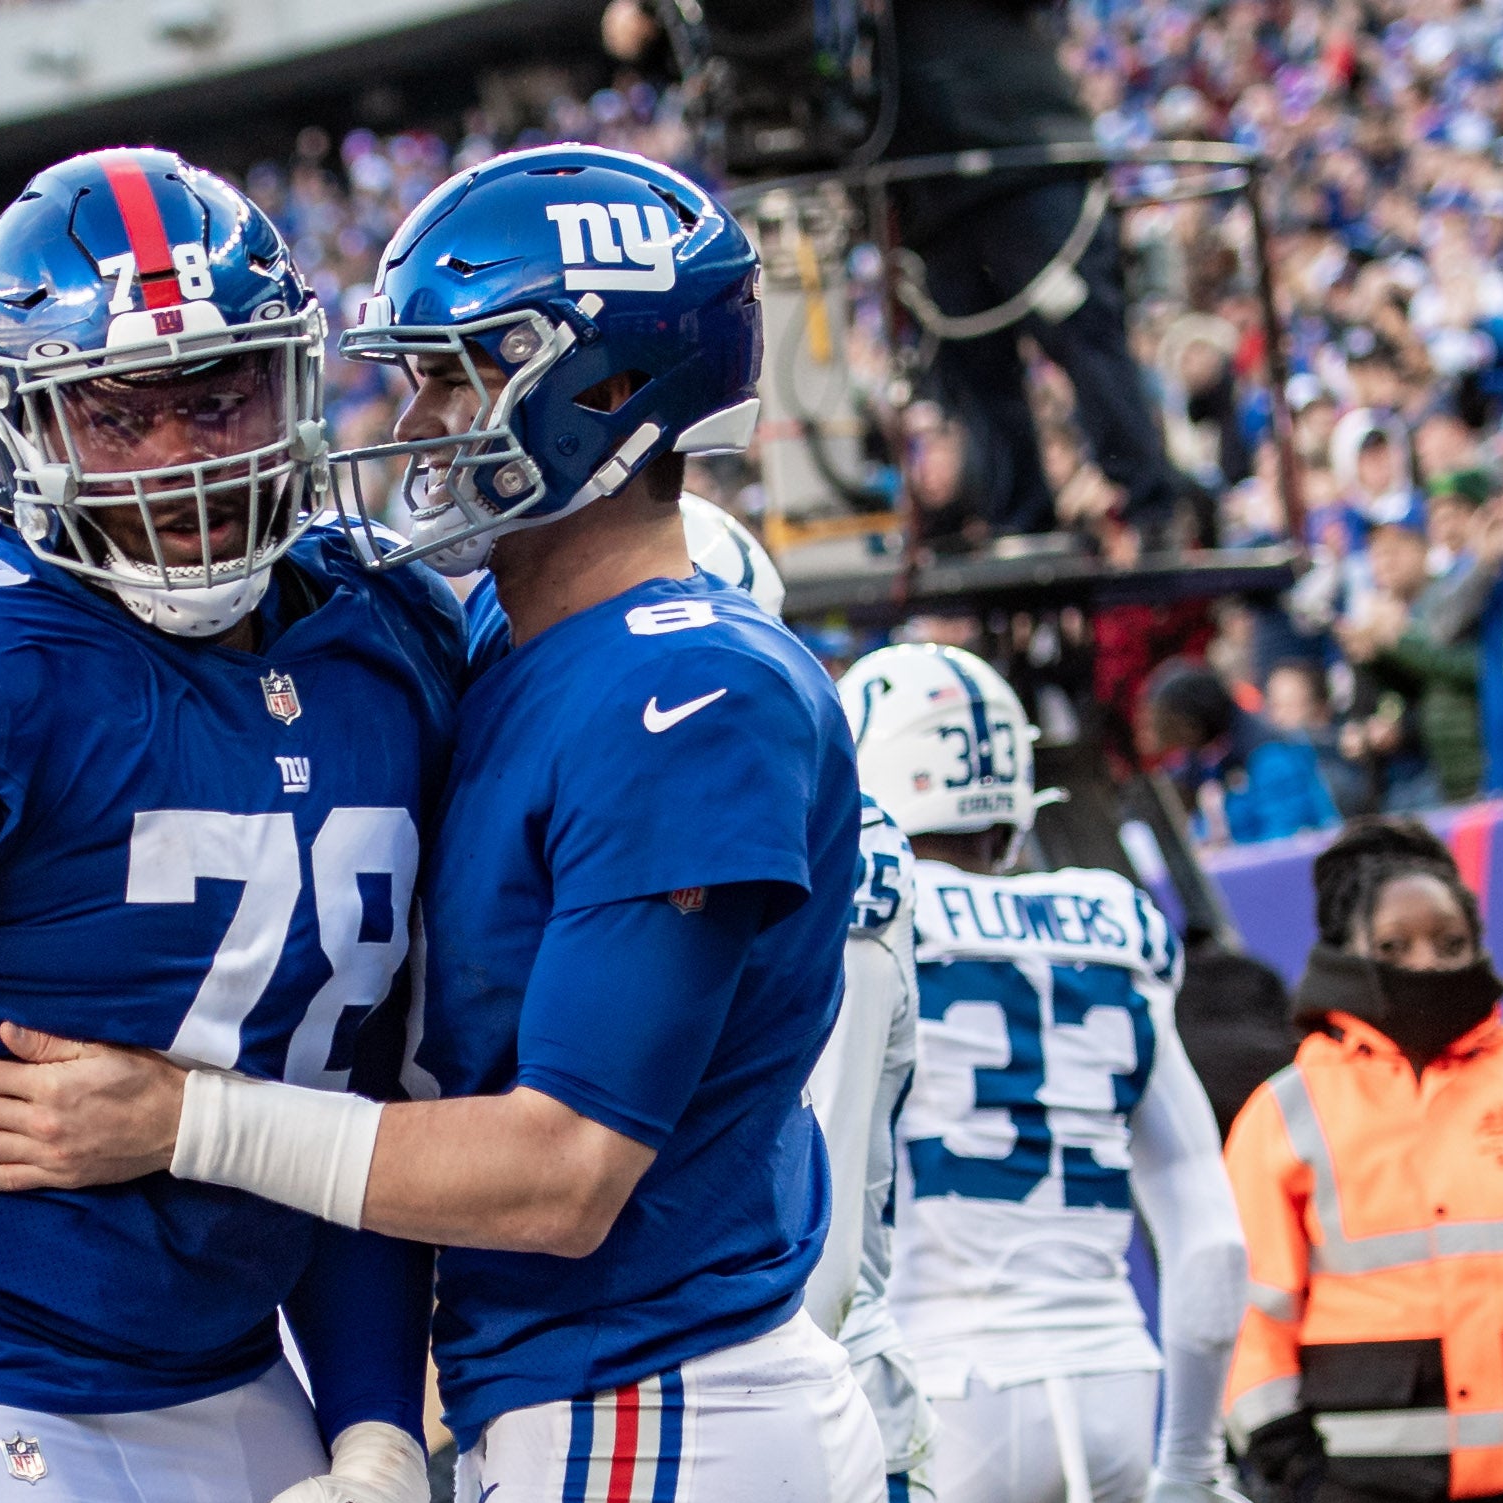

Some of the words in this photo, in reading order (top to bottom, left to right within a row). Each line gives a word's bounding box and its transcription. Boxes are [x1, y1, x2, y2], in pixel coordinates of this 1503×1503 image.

[98, 243, 215, 315] 78
[938, 722, 1017, 788] 33
[852, 852, 901, 929] 5
[936, 886, 1127, 947] FLOWERS
[125, 807, 442, 1100] 78
[906, 958, 1156, 1212] 33
